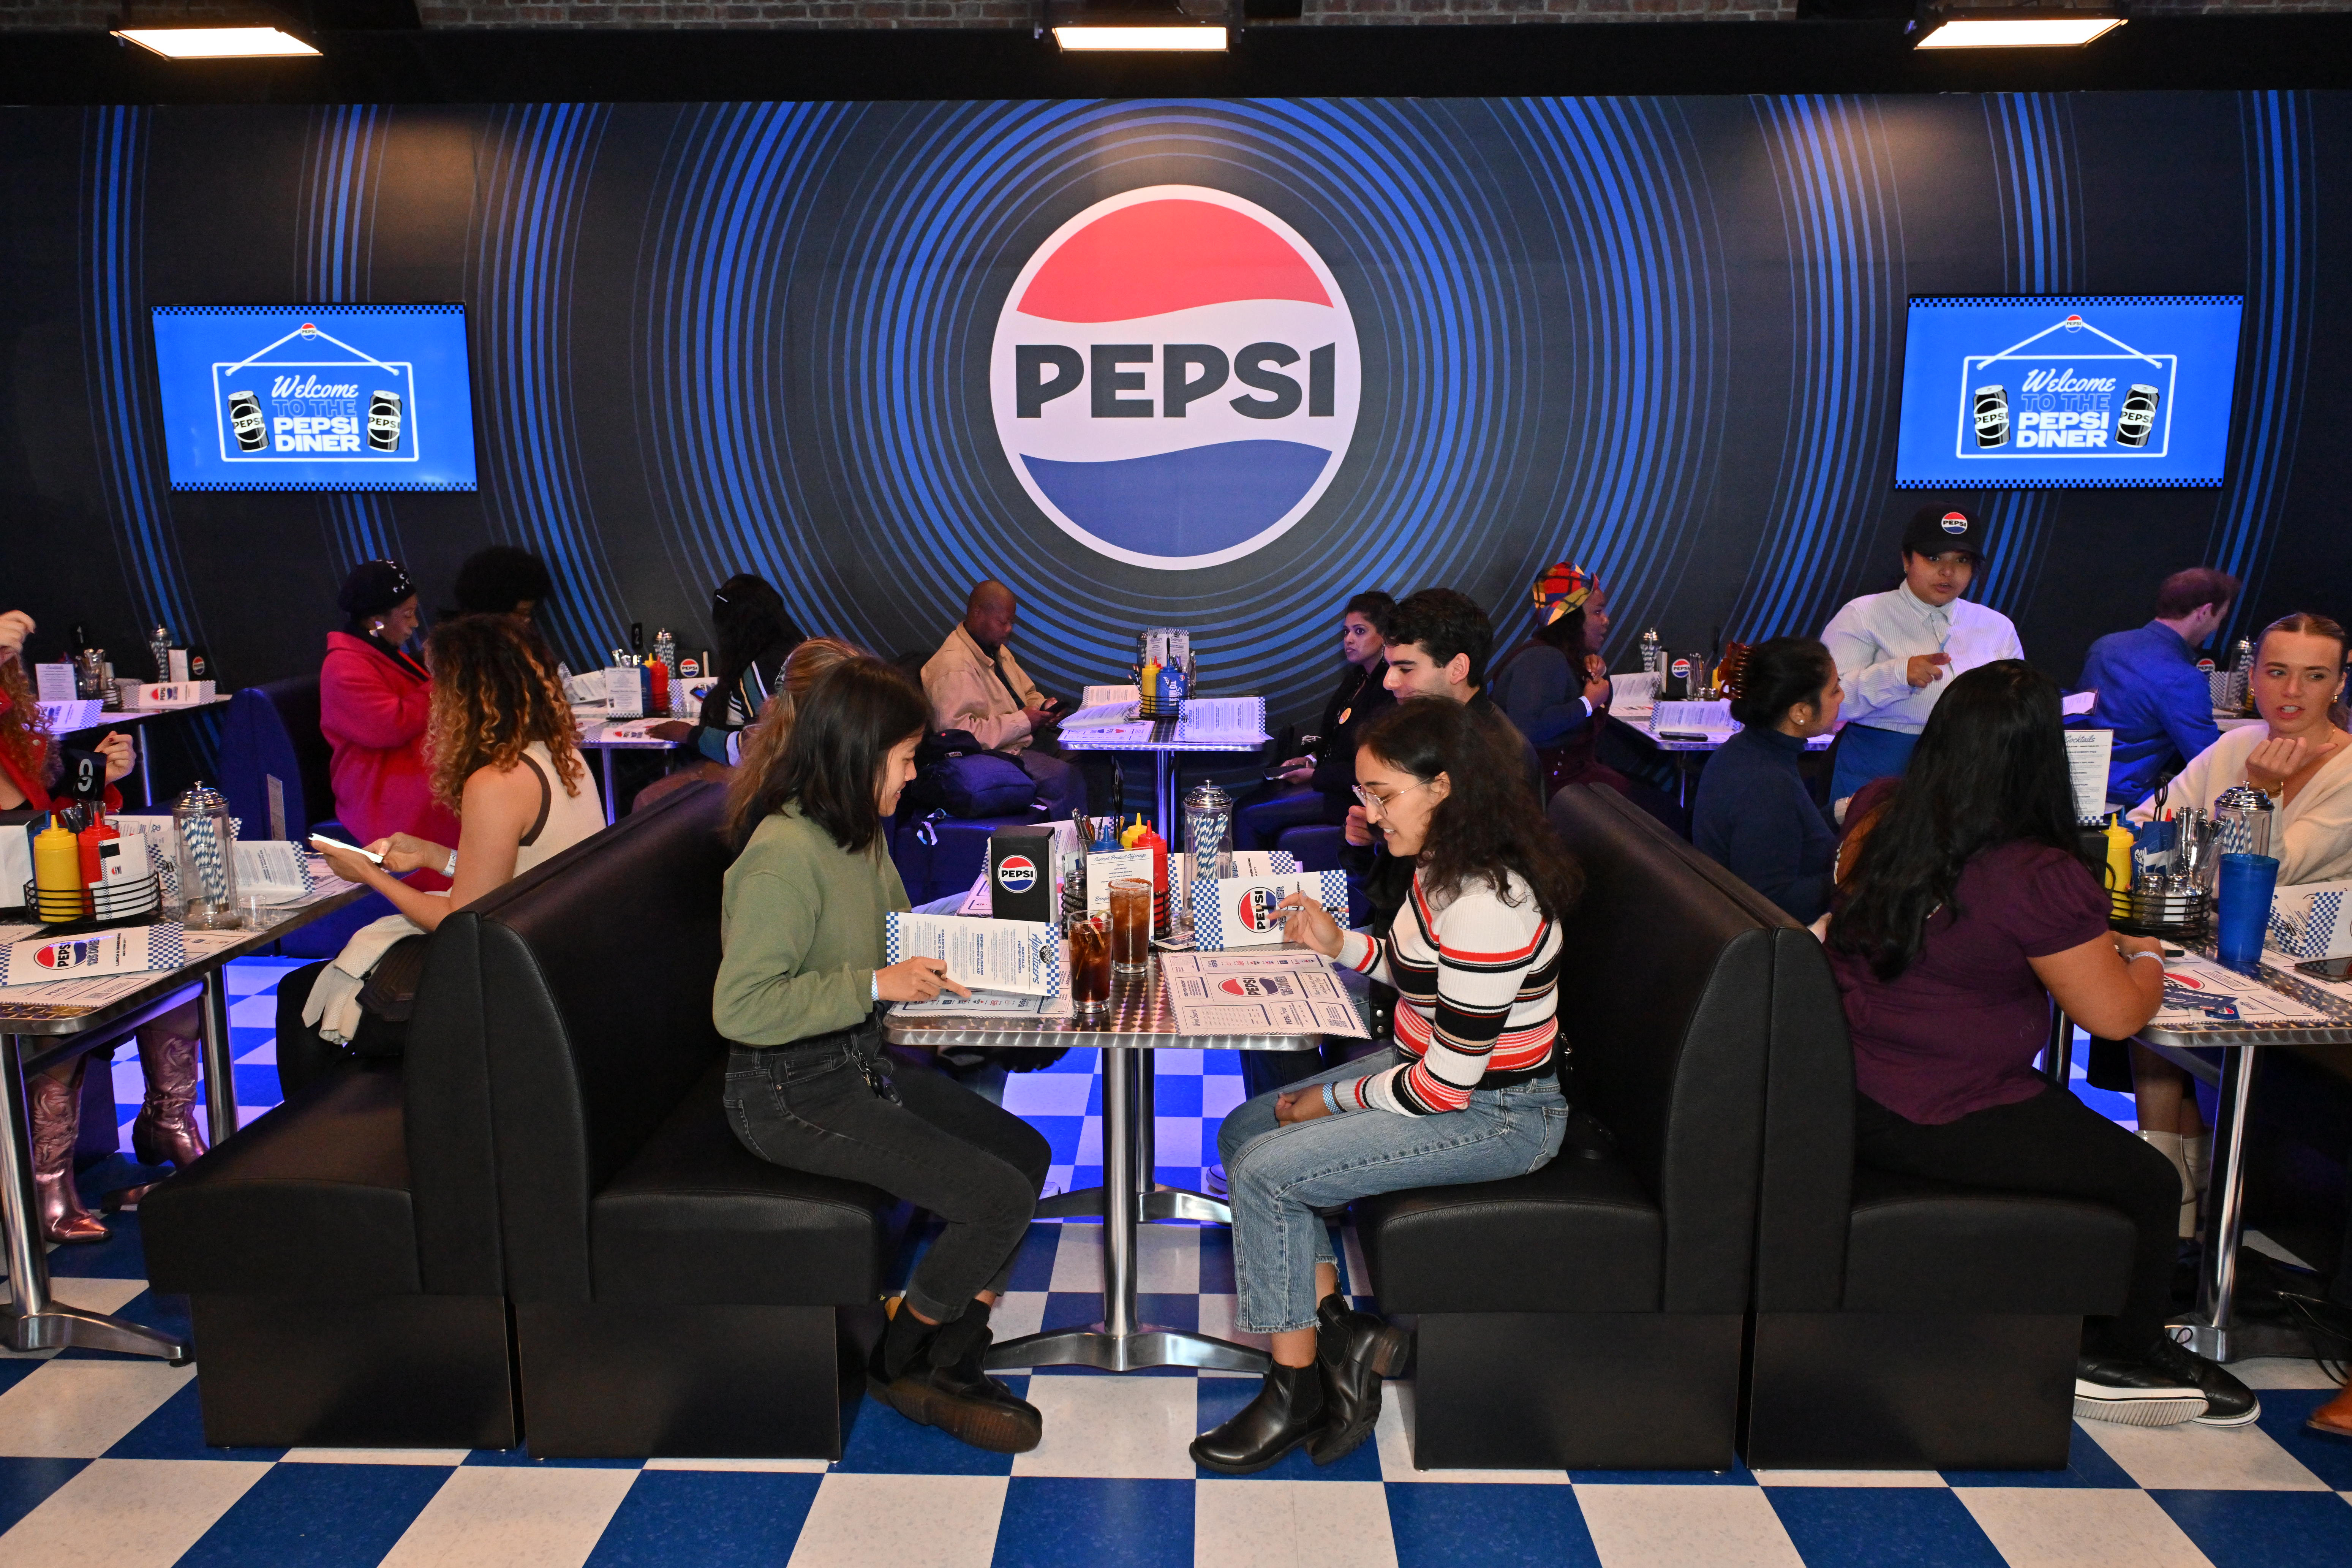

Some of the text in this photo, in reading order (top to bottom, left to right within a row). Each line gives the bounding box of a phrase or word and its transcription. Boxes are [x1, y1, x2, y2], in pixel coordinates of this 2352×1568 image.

[271, 374, 359, 398] Welcome
[1015, 341, 1335, 419] PEPSI
[2022, 368, 2116, 392] Welcome
[273, 399, 357, 417] TO THE
[2022, 394, 2111, 412] TO THE
[232, 416, 263, 430] PEPSI
[273, 417, 359, 434] PEPSI
[368, 416, 400, 429] PEPSI
[1975, 413, 2009, 424] PEPSI
[2018, 412, 2109, 430] PEPSI
[2120, 411, 2155, 424] PEPSI
[275, 434, 361, 452] DINER
[2016, 430, 2108, 448] DINER
[1169, 680, 1177, 689] TO
[78, 759, 93, 792] 9
[1254, 891, 1266, 930] PEPSI
[1278, 915, 1287, 931] 125
[87, 937, 100, 954] DINE
[57, 944, 71, 967] PEPS
[1028, 933, 1043, 984] Appetizers
[45, 986, 67, 995] PEPSI
[1242, 978, 1261, 995] PEPSI
[1274, 976, 1291, 988] DINER
[1188, 1009, 1198, 1018] Search
[1283, 1015, 1293, 1024] PEPSI
